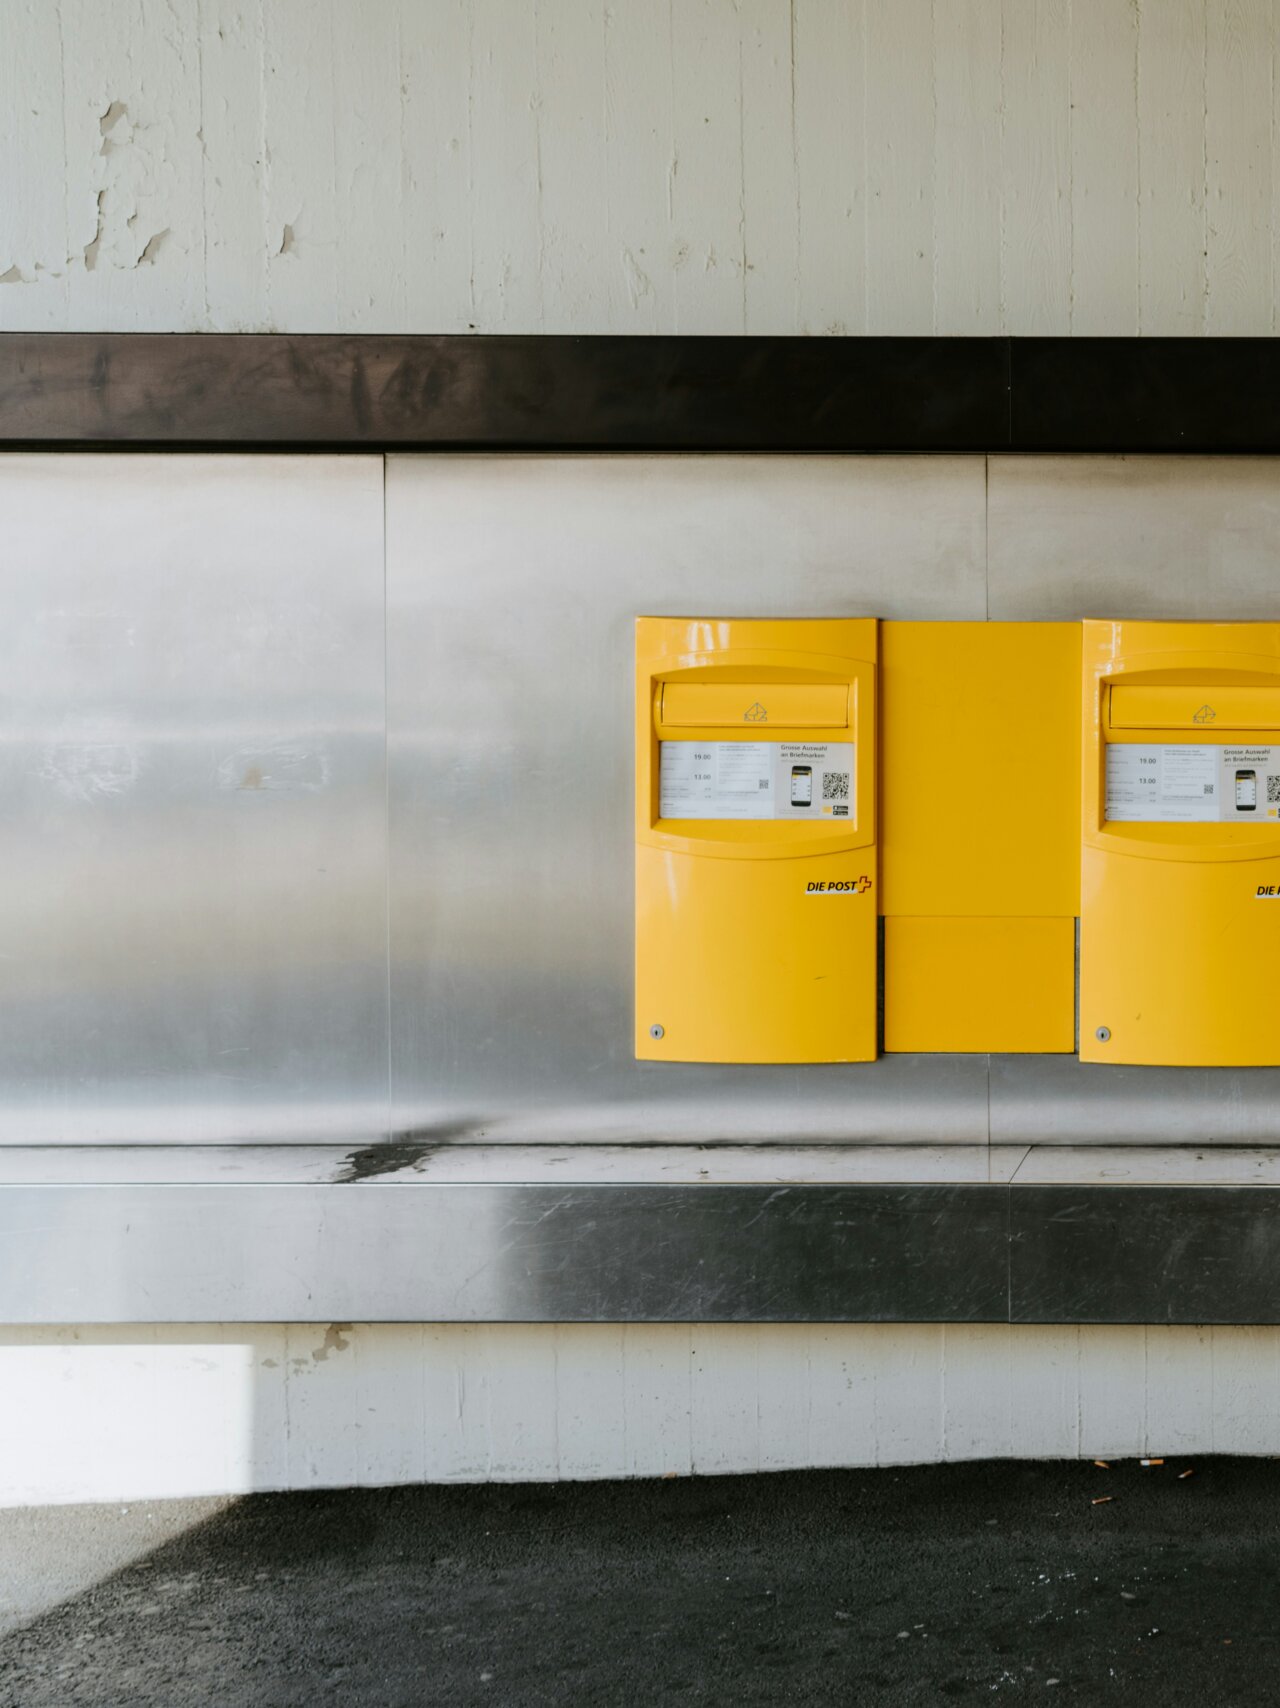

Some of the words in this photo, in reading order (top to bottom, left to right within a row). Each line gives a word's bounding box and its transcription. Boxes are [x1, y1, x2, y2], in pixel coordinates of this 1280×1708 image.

[807, 882, 826, 891] DIE
[828, 881, 858, 891] POST
[1257, 886, 1275, 895] DIE
